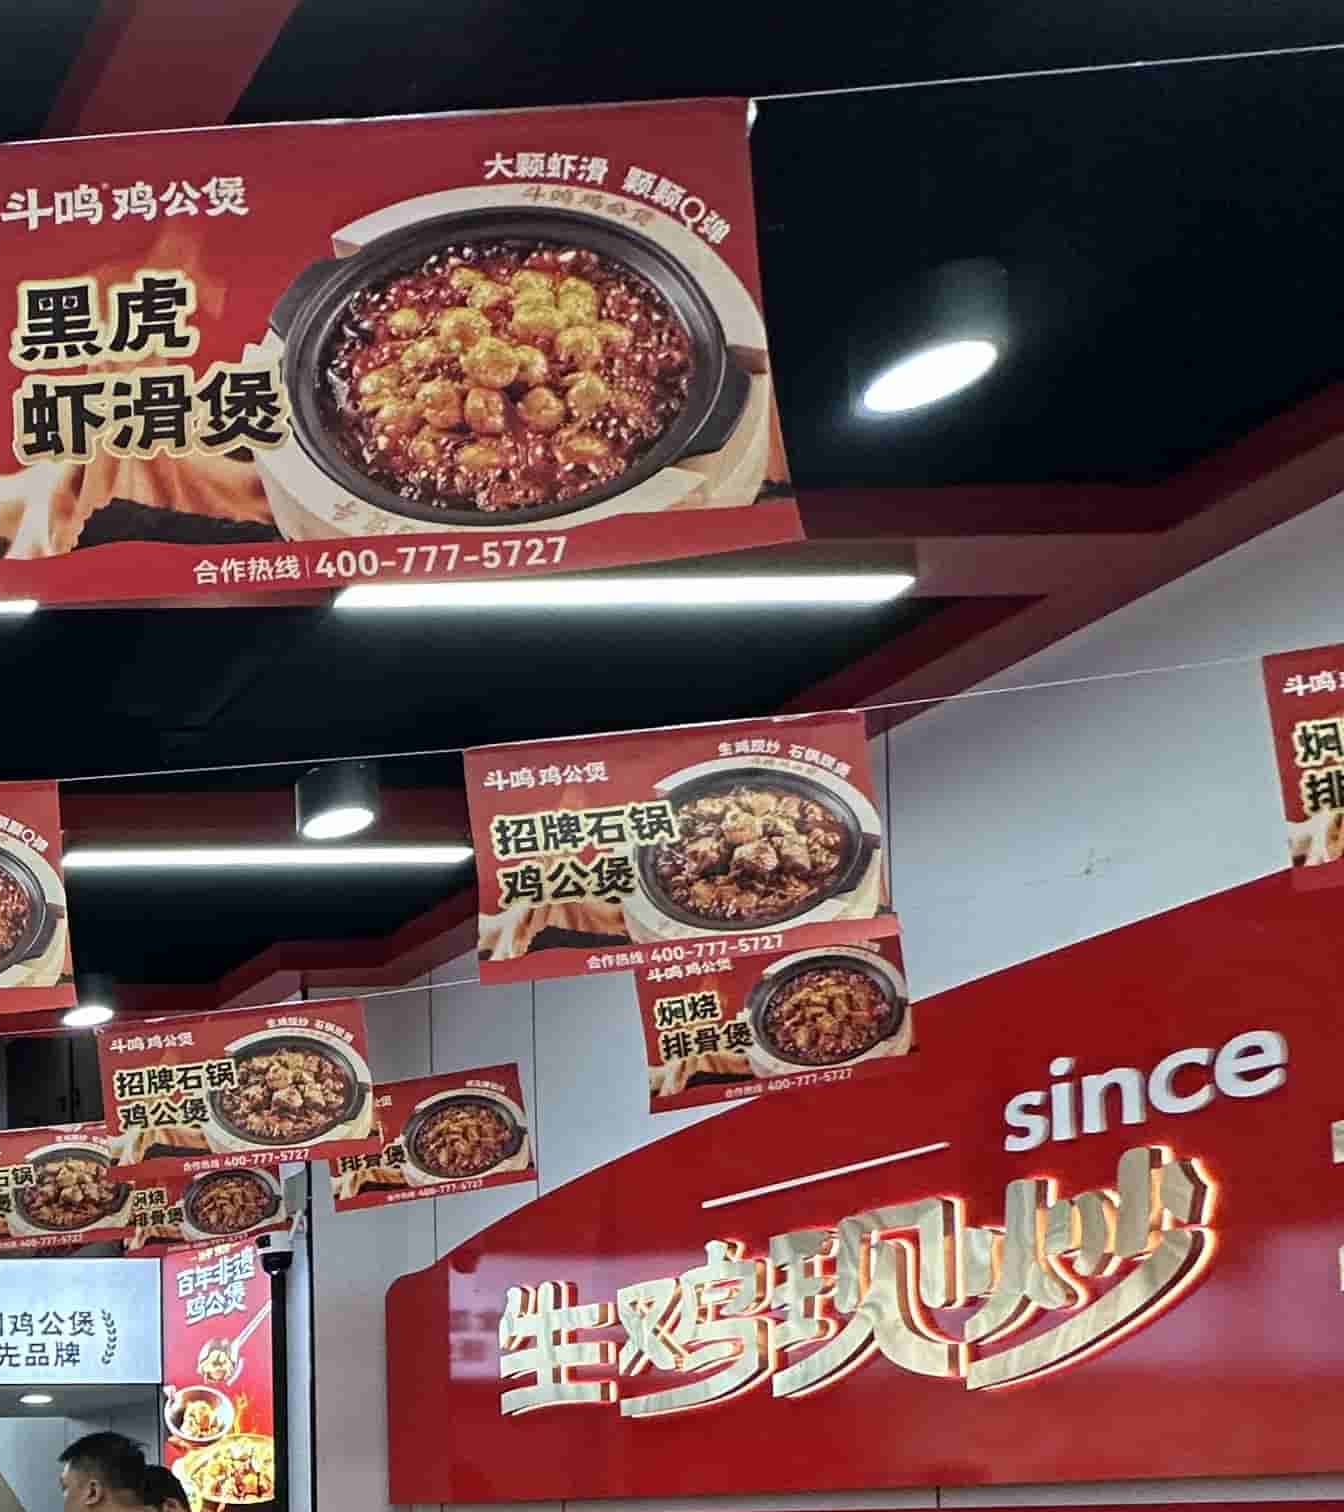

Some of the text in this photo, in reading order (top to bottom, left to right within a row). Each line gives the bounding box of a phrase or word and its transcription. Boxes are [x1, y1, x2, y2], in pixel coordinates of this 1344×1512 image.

[483, 152, 609, 186] 大颗虾滑
[0, 176, 249, 233] 斗鸣鸡公煲
[21, 278, 193, 359] 黑虎
[21, 370, 283, 461] 虾滑煲
[193, 536, 568, 586] 合作热线 400-777-5727
[483, 762, 609, 791] 斗鸣鸡公煲
[494, 804, 674, 857] 招牌石锅
[501, 855, 635, 905] 鸡公煲
[650, 935, 784, 963] 400-777-5727
[657, 993, 719, 1027] 焖烧
[662, 1022, 753, 1061] 排骨煲
[116, 1061, 237, 1097] 招牌石锅
[768, 1069, 852, 1091] 400-777-5727
[1005, 1029, 1287, 1153] since
[120, 1098, 210, 1130] 鸡公煲
[500, 1145, 1217, 1417] 生鸡现炒
